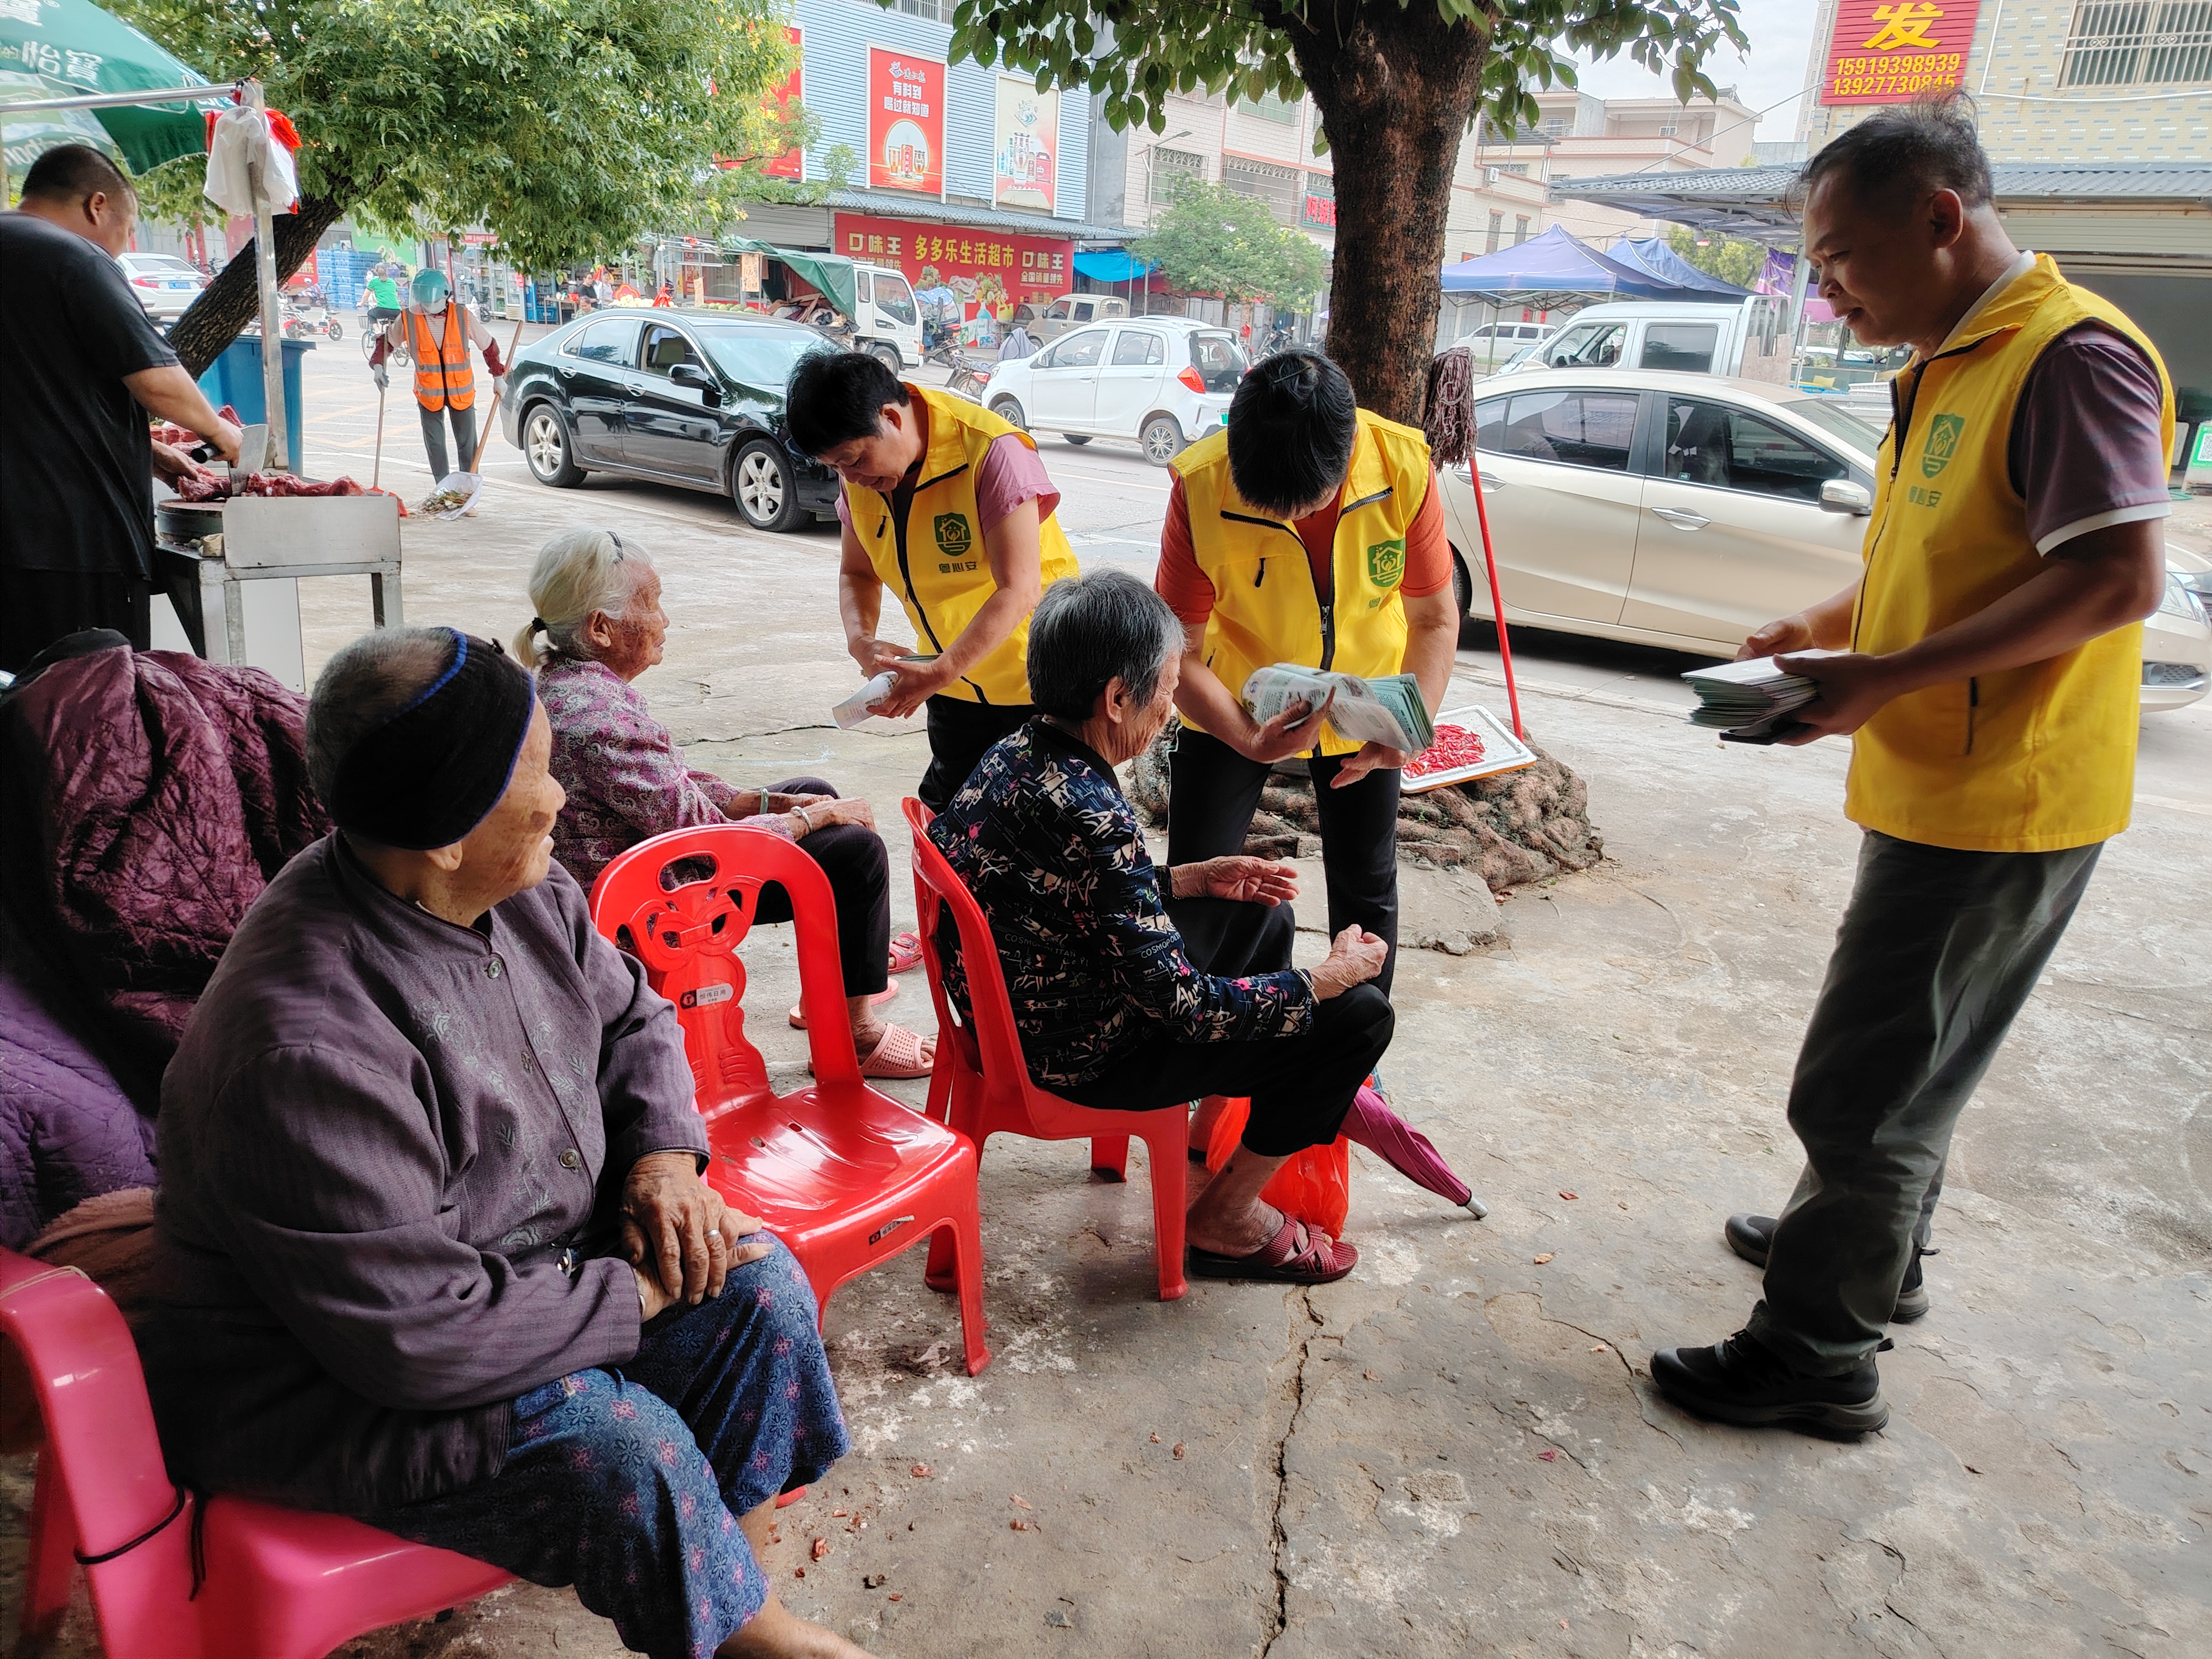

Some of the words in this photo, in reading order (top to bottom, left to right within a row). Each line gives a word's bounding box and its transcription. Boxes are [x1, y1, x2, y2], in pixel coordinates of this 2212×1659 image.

[1860, 2, 1944, 51] 发
[1837, 53, 1960, 76] 15919398939
[1833, 74, 1957, 95] 13927730845
[884, 96, 930, 118] 喝过就知道
[848, 232, 902, 255] 口味王
[915, 234, 1015, 268] 多多乐生活超市
[1021, 251, 1064, 270] 口味王
